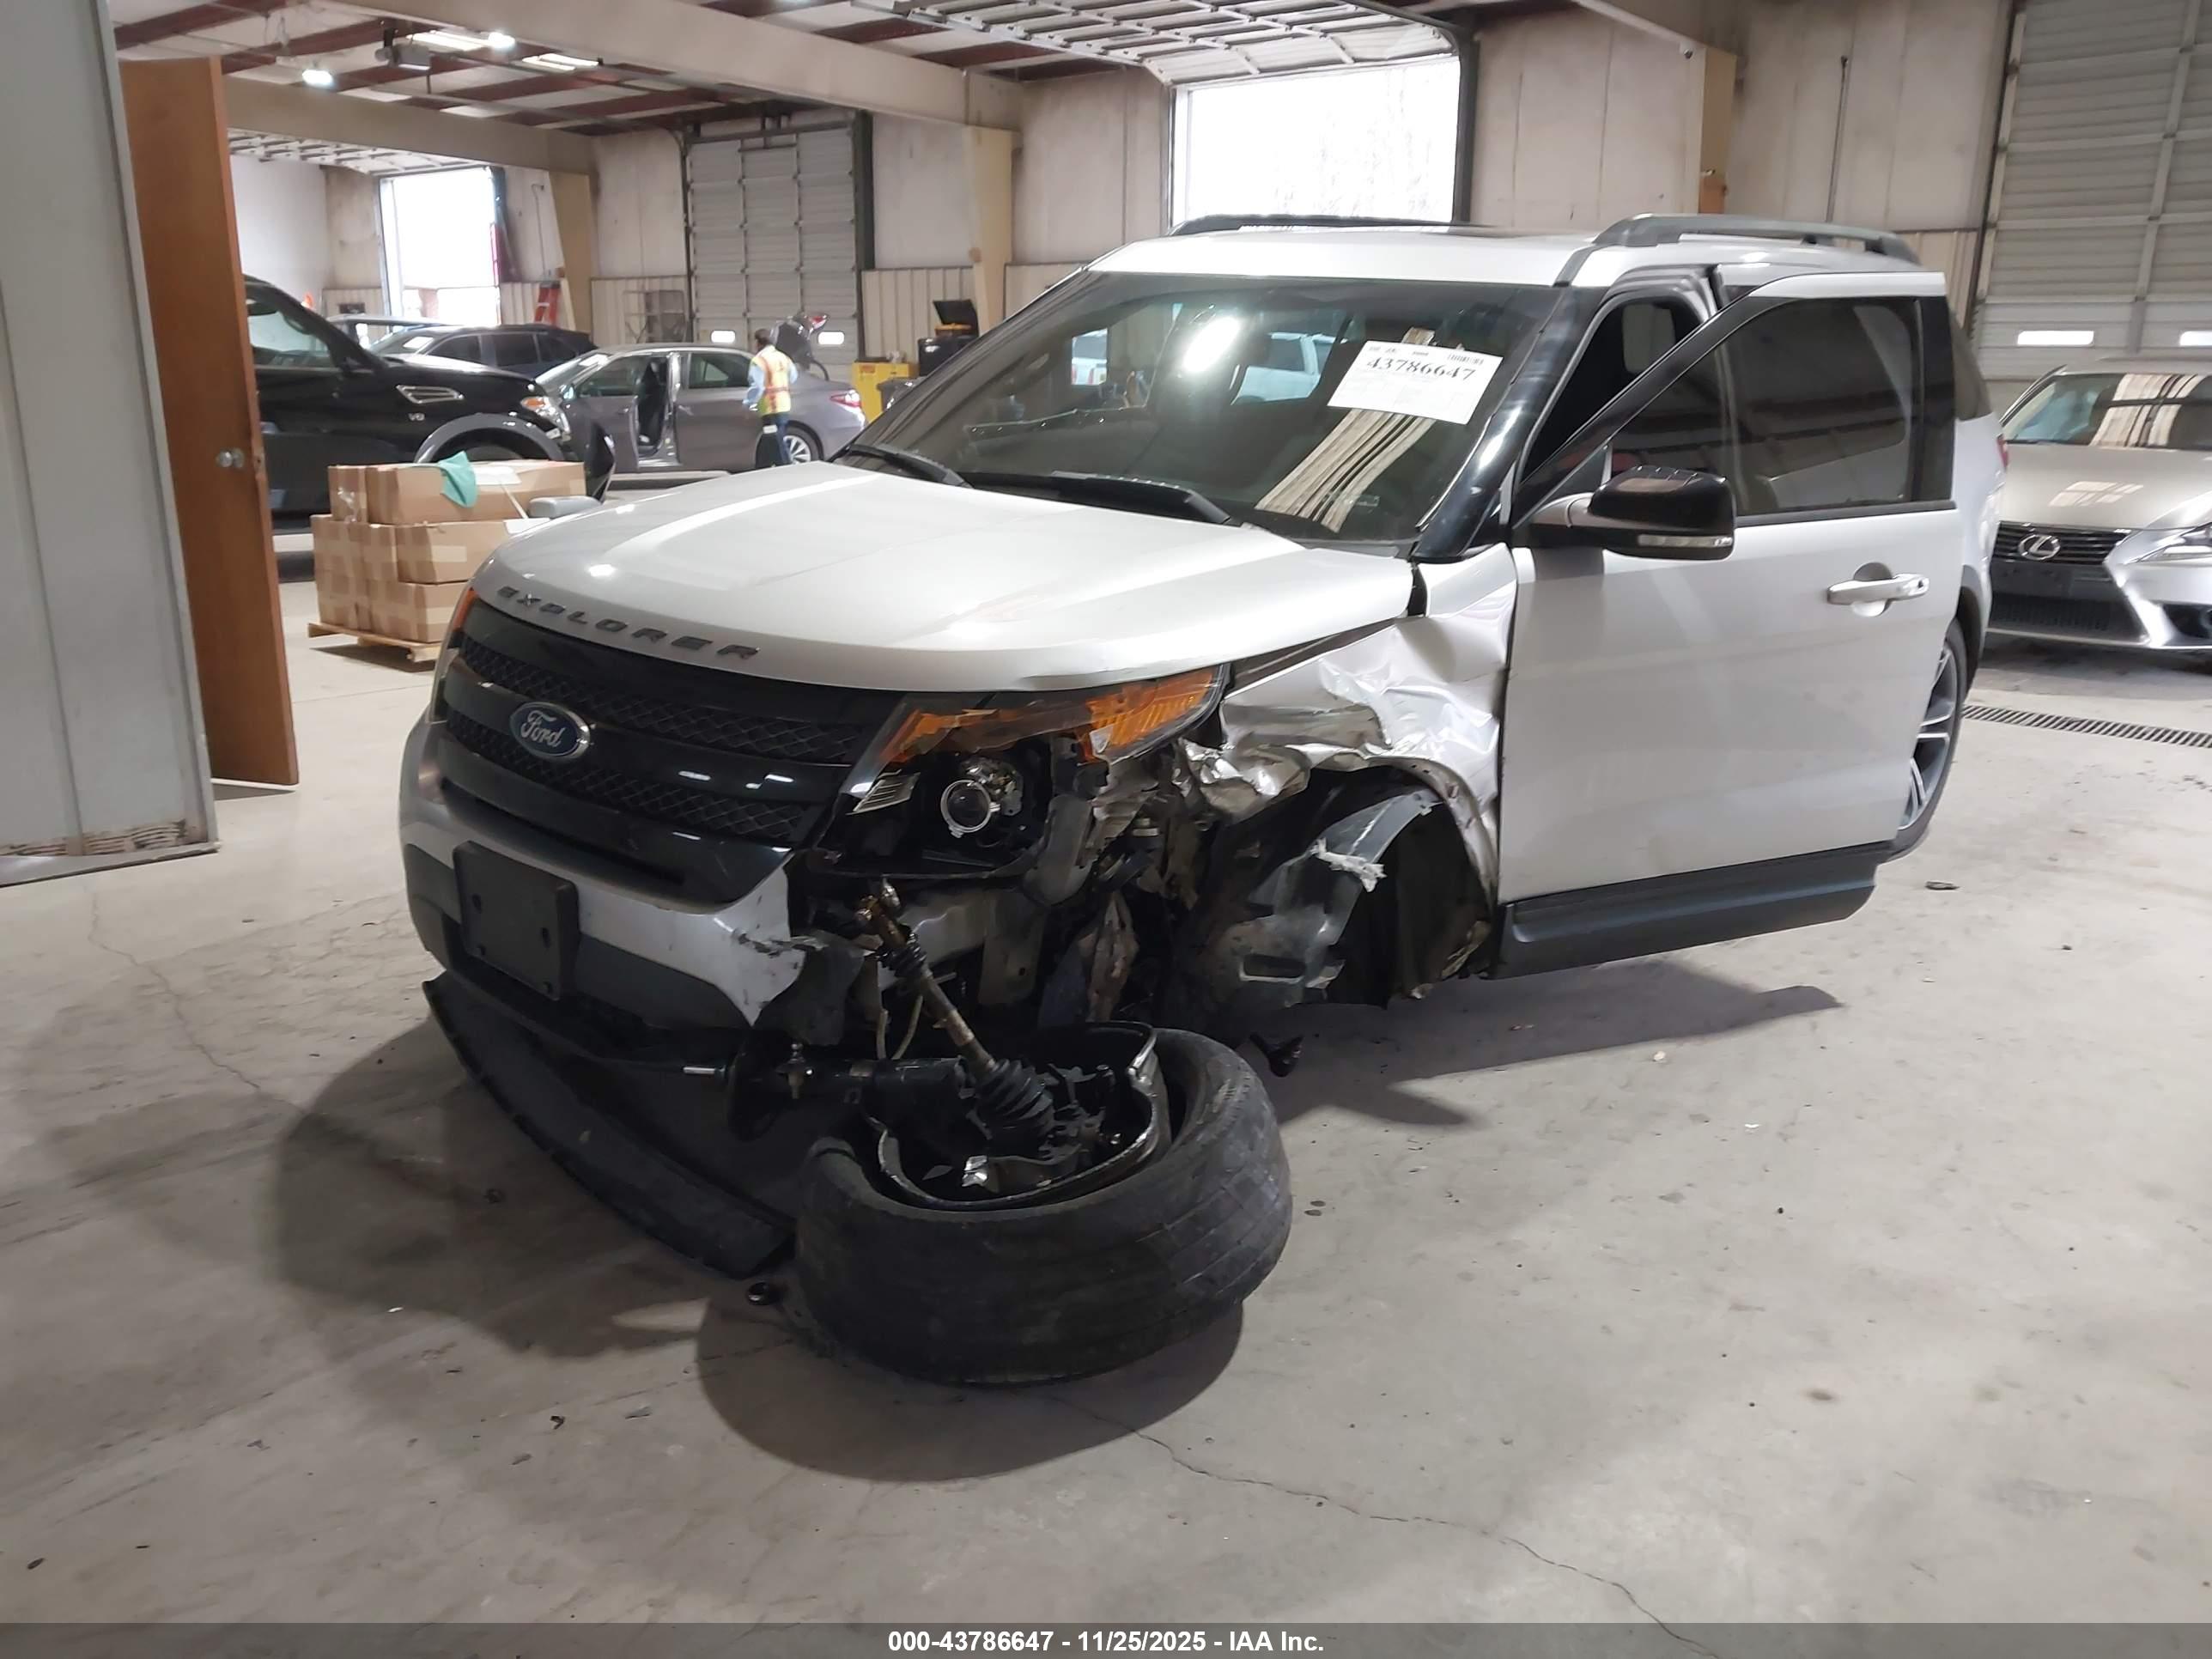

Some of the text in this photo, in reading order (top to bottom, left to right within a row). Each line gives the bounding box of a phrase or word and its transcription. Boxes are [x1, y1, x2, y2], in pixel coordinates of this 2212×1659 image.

[1366, 356, 1477, 380] 43786647
[496, 585, 761, 659] EXPLORER
[520, 709, 566, 748] Ford
